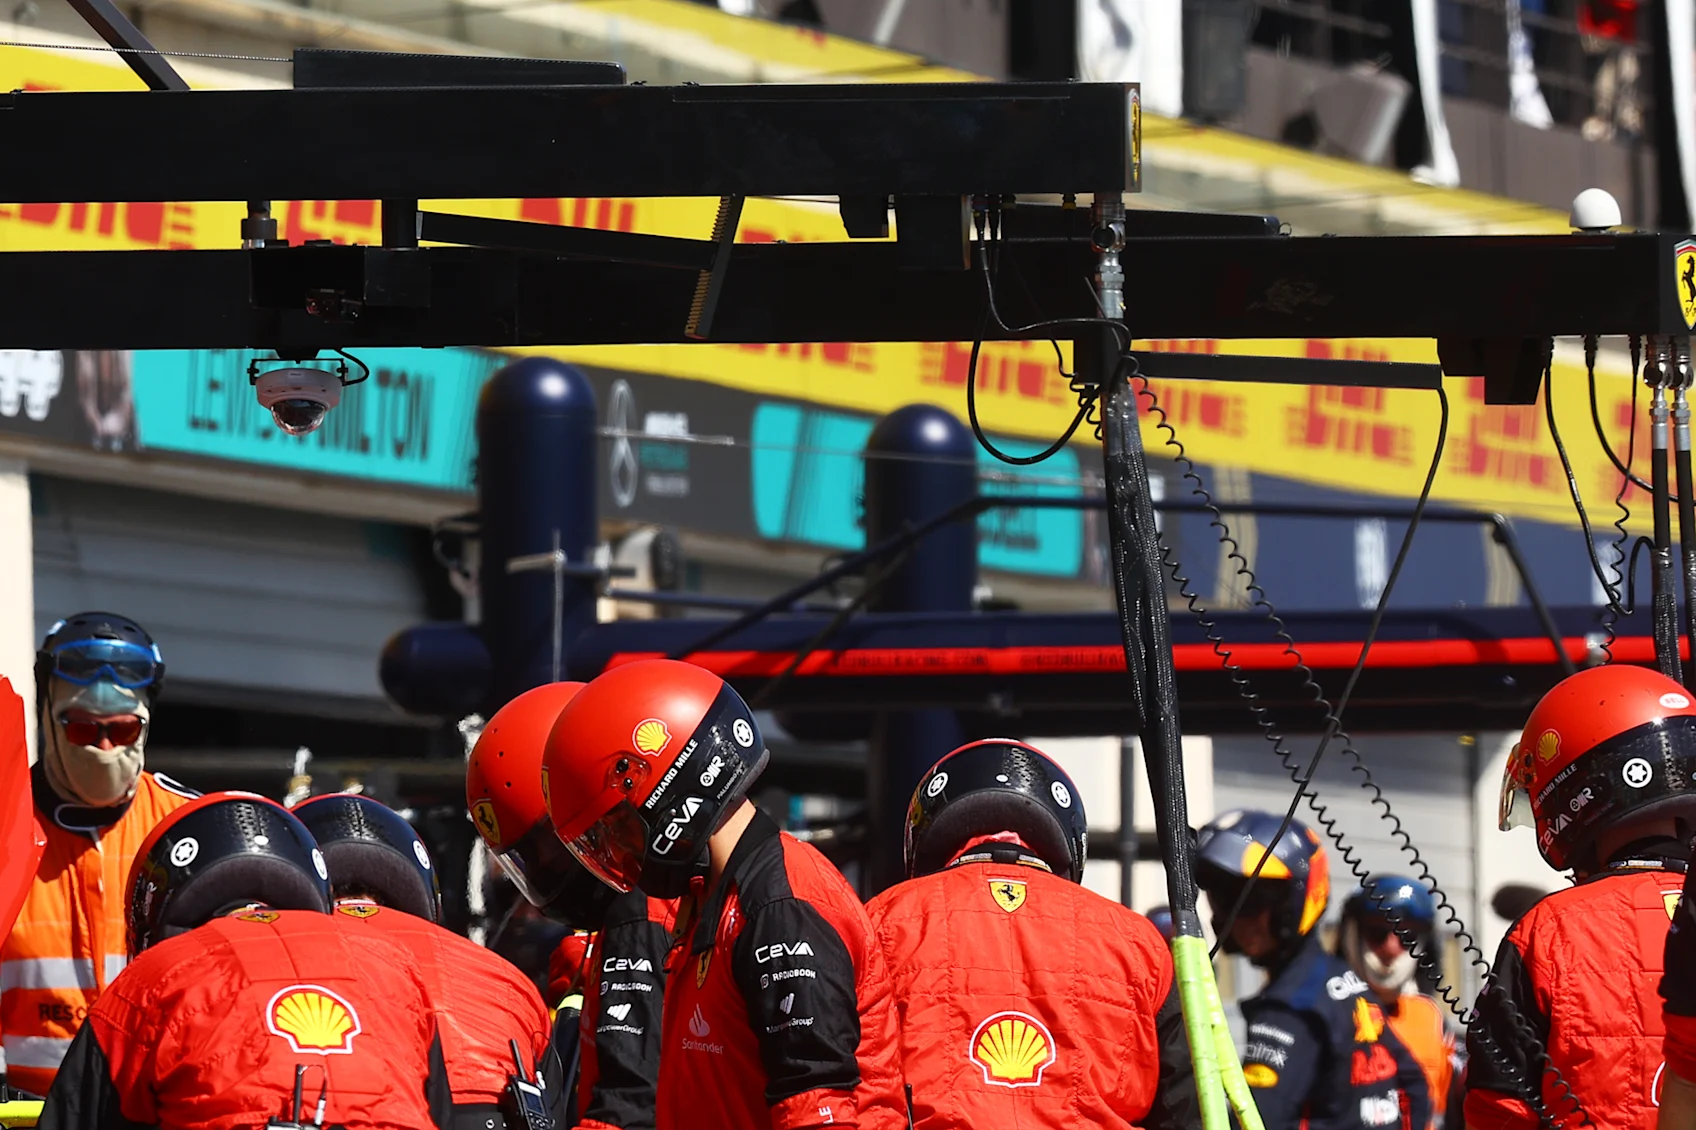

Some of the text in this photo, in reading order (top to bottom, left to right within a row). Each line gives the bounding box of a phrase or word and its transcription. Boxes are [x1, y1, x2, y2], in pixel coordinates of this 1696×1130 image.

[645, 739, 699, 810] RICHARD MILLE
[681, 1037, 724, 1055] Santander
